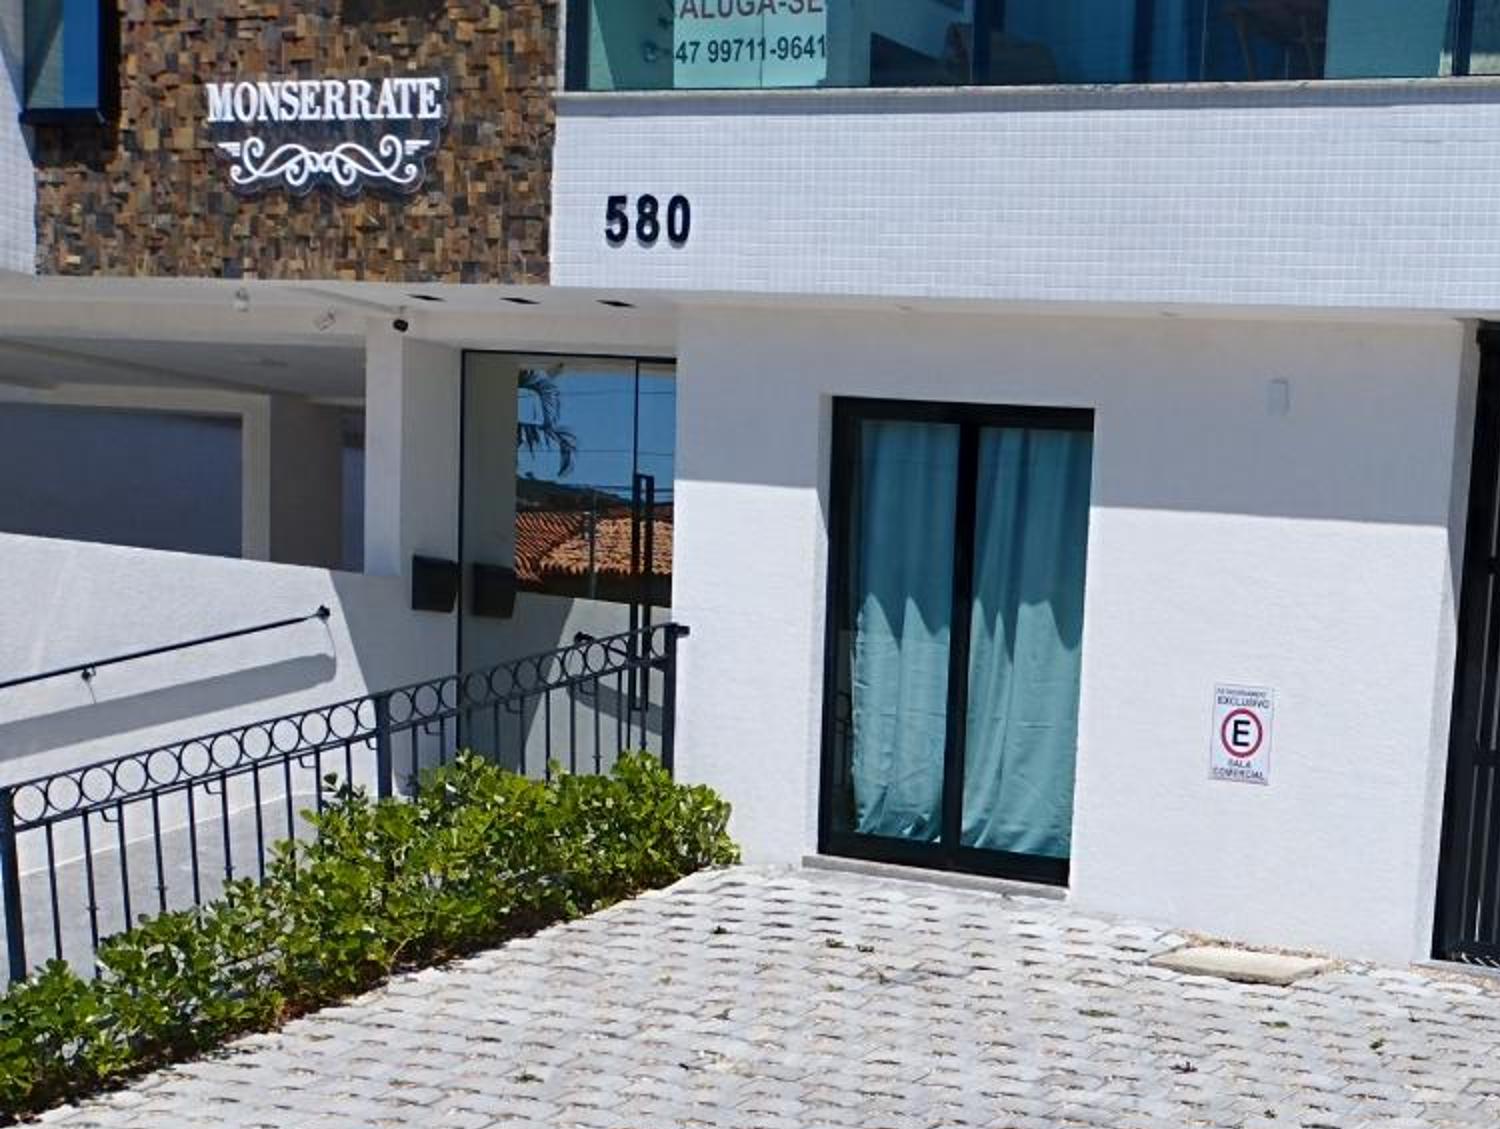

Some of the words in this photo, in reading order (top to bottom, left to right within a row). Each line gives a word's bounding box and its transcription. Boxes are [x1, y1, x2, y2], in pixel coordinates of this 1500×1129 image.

[675, 41, 700, 64] 47
[707, 34, 826, 63] 99711-9641
[206, 77, 441, 123] MONSERRATE
[604, 193, 691, 246] 580
[1232, 719, 1251, 747] E
